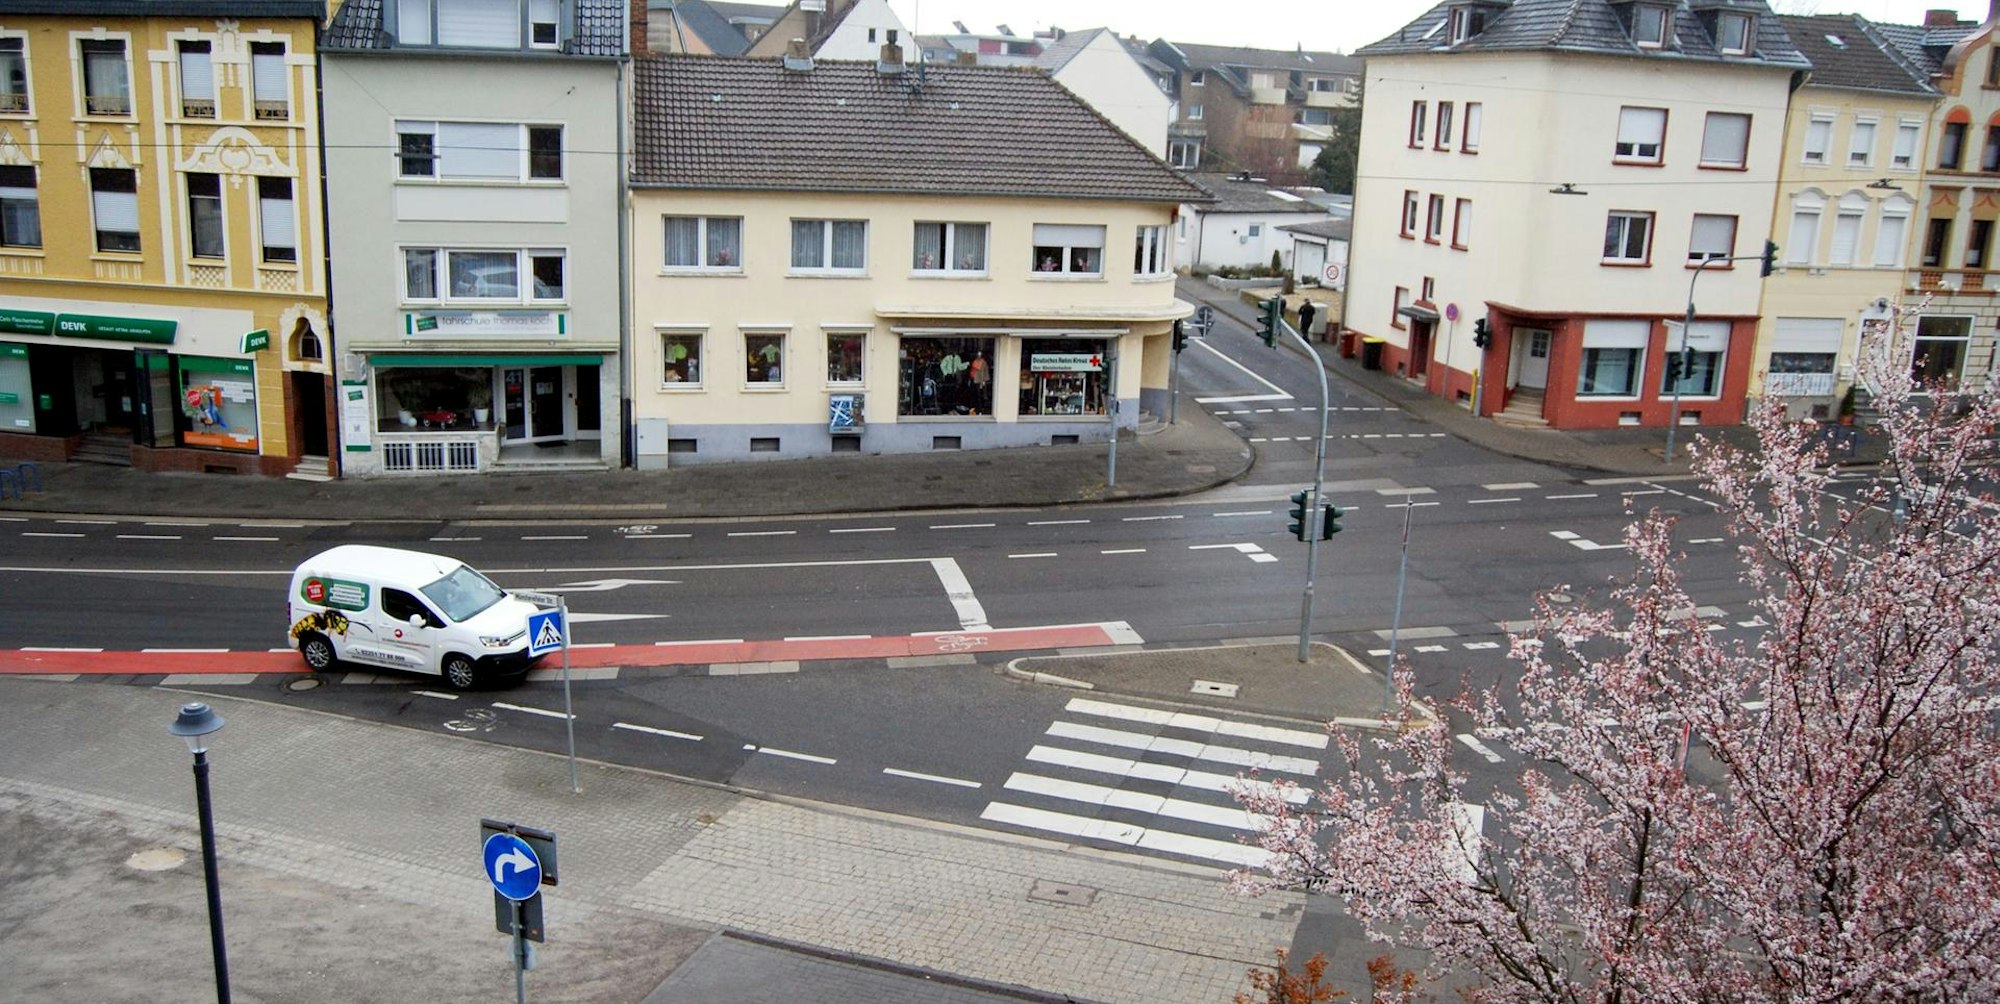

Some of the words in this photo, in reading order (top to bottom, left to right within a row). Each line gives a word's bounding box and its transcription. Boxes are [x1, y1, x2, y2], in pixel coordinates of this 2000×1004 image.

[442, 316, 491, 325] fahrschule
[61, 321, 87, 332] DEVK
[251, 336, 266, 347] DEVK
